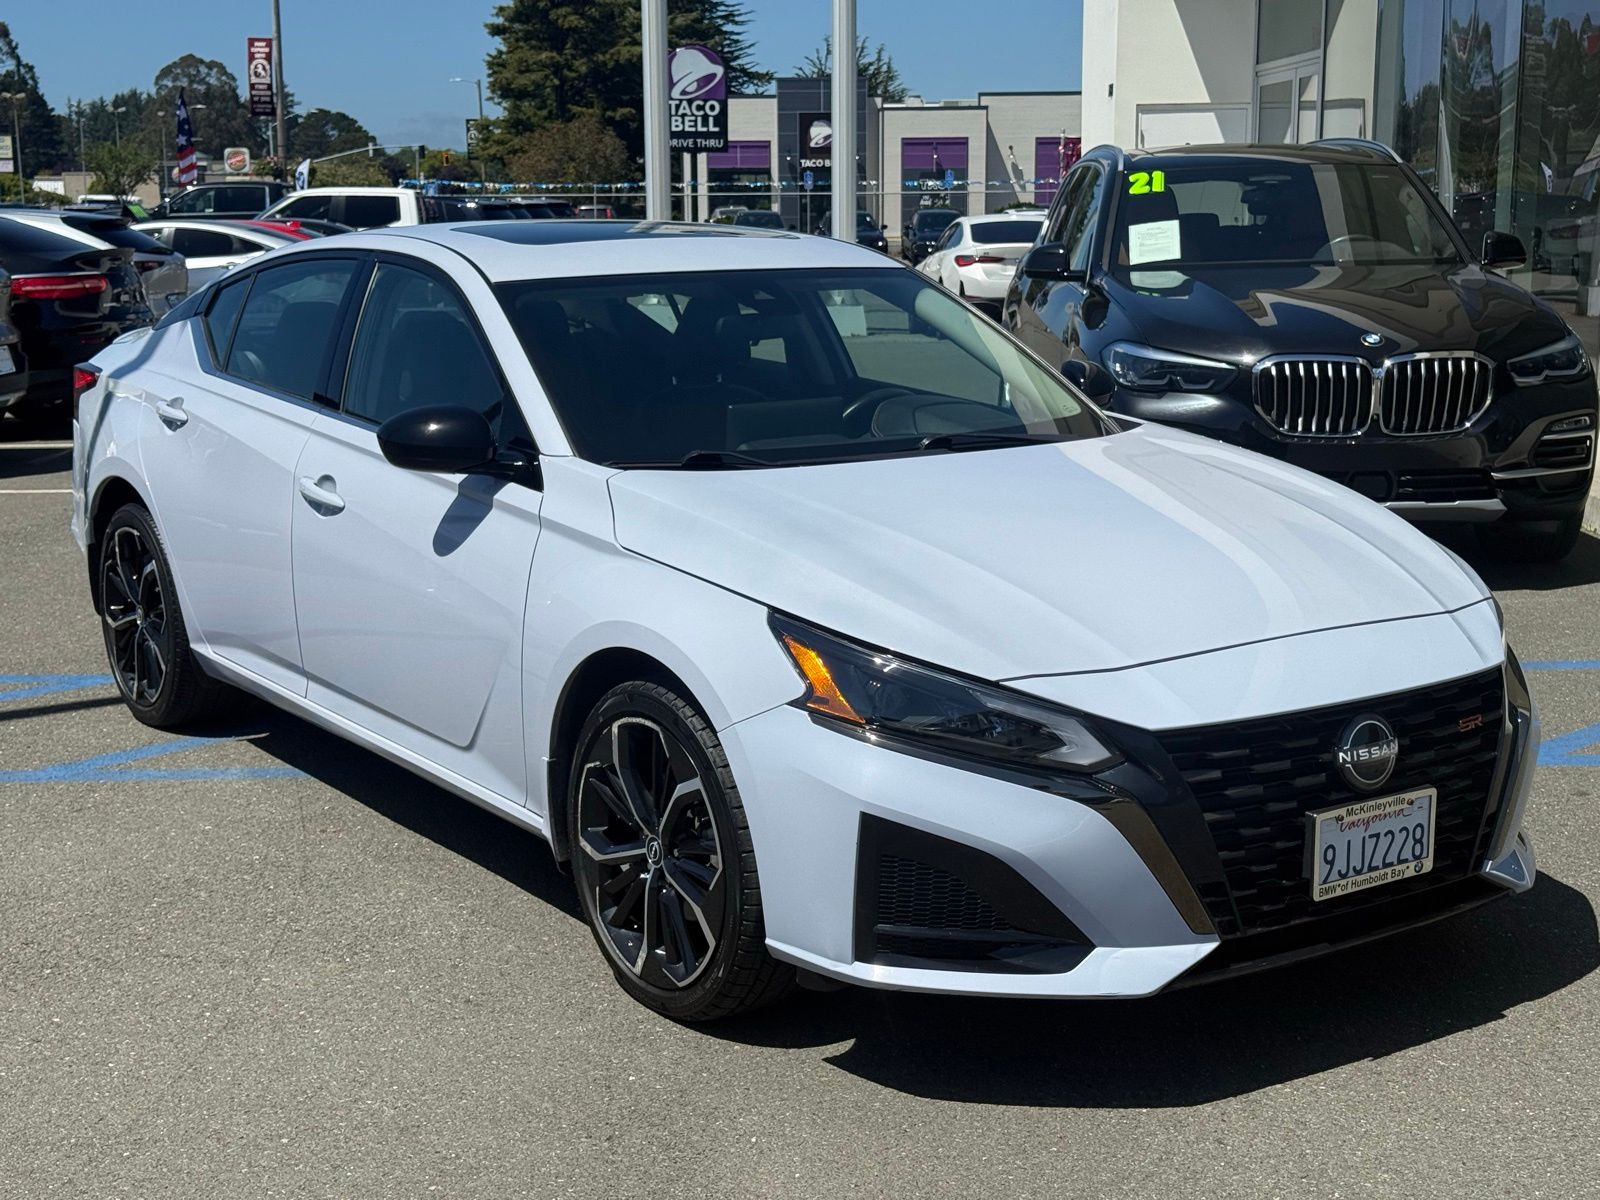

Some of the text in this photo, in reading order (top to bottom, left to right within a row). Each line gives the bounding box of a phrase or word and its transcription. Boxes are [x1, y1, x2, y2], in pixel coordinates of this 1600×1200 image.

[669, 100, 720, 116] TACO
[671, 116, 720, 132] BELL
[696, 138, 724, 148] THRU
[800, 159, 824, 168] TACO
[1129, 170, 1164, 195] 21
[1458, 714, 1483, 732] SR
[1338, 737, 1399, 763] NISSAN
[1345, 796, 1406, 818] McKinleyville
[1322, 822, 1425, 884] 9JJZ228
[1340, 882, 1349, 892] of
[1350, 872, 1389, 889] Humboldt
[1391, 868, 1406, 879] Bay
